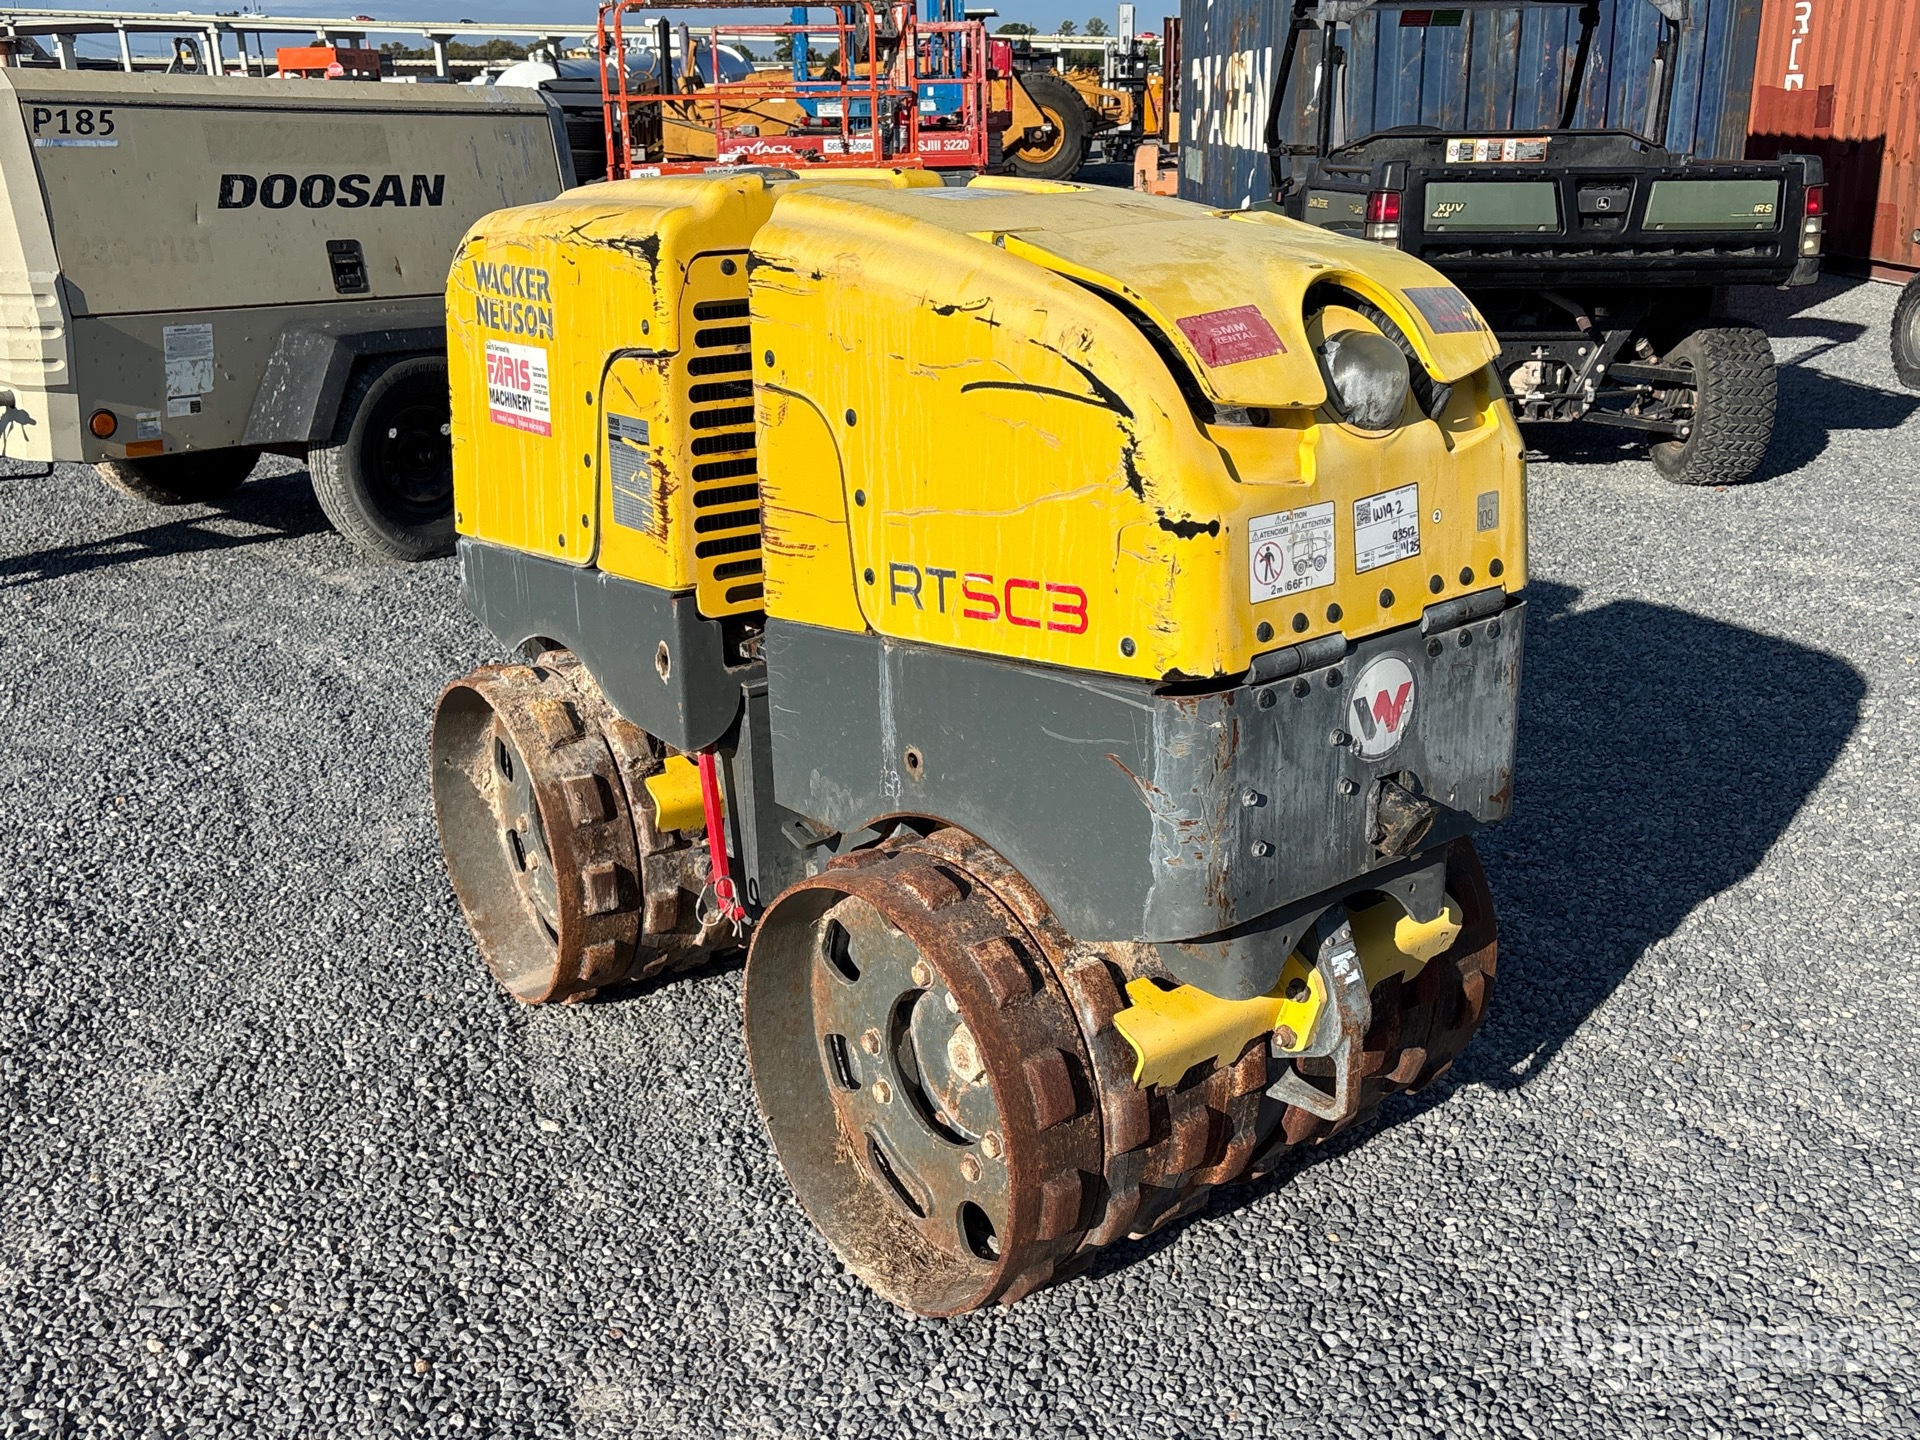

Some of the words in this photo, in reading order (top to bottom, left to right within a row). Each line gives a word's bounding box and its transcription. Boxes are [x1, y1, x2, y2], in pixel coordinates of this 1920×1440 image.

[33, 107, 115, 136] P185
[943, 139, 970, 151] 3220
[217, 173, 446, 210] DOOSAN
[1437, 202, 1466, 213] XUV
[1753, 203, 1774, 214] IRS
[473, 260, 552, 304] WACKER
[476, 295, 554, 341] NEUSON
[1210, 322, 1249, 337] SMM
[1212, 331, 1258, 346] RENTAL
[487, 353, 532, 392] FARIS
[488, 387, 533, 413] MACHINERY
[1434, 511, 1440, 521] 2
